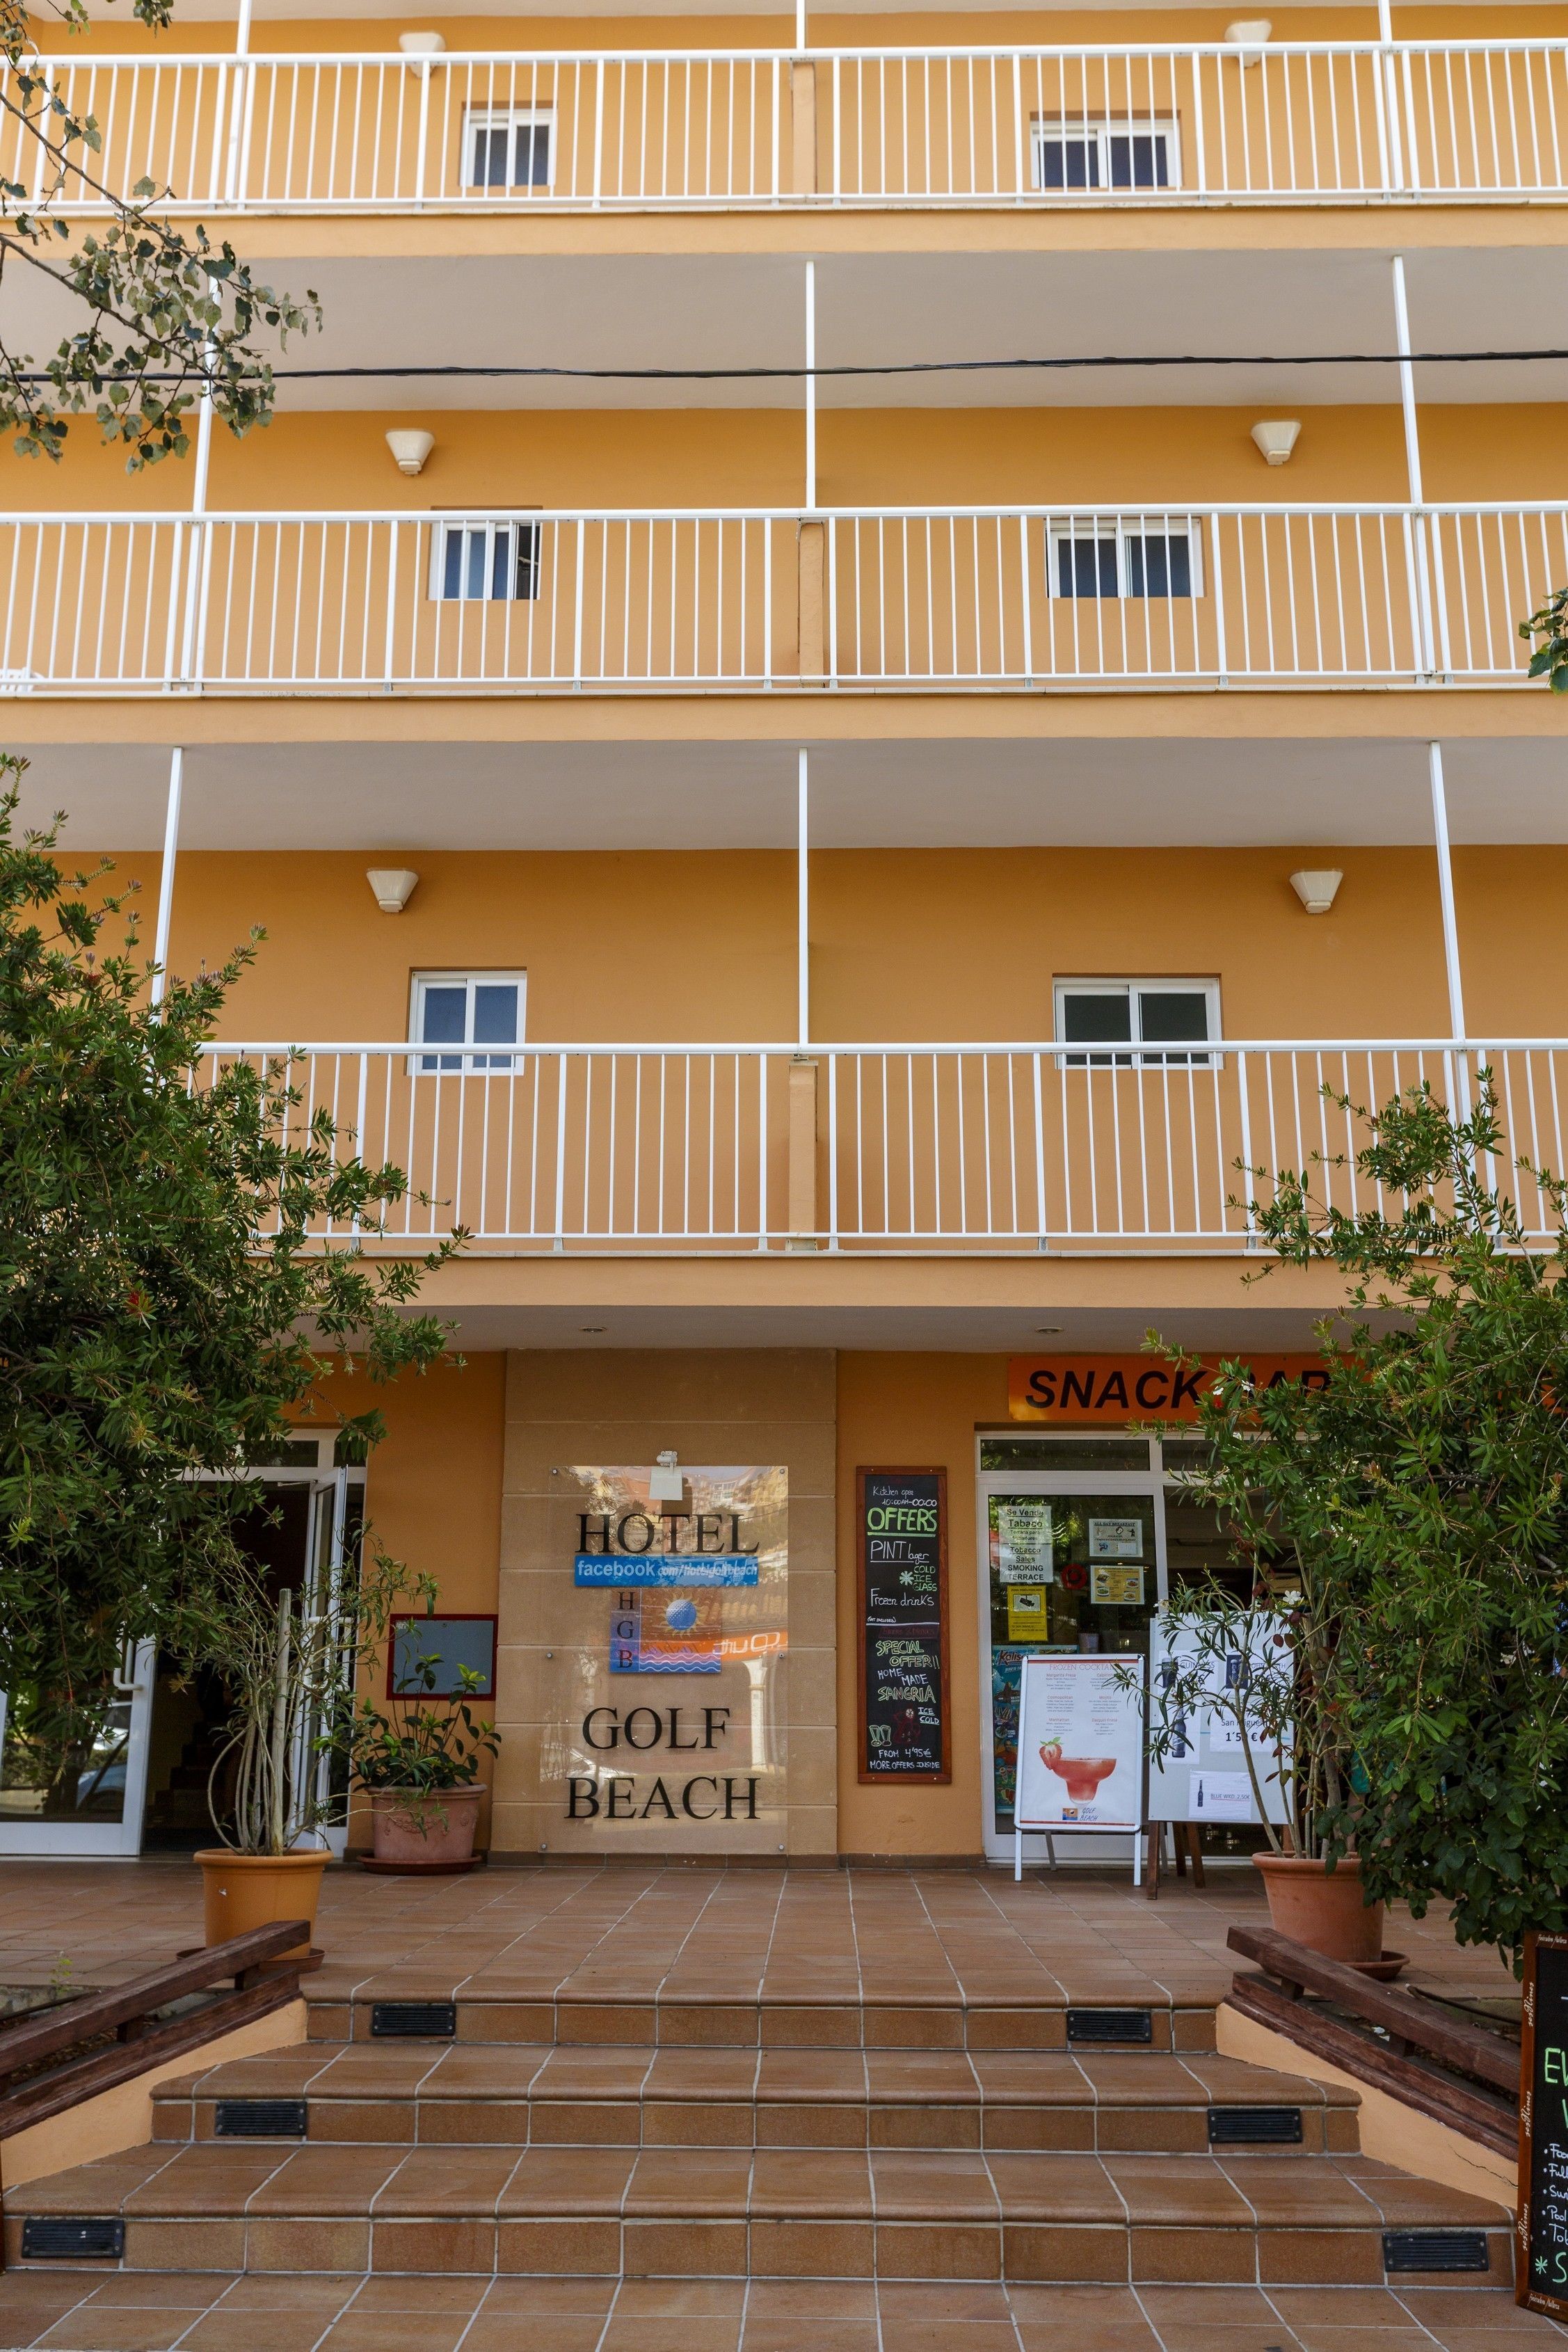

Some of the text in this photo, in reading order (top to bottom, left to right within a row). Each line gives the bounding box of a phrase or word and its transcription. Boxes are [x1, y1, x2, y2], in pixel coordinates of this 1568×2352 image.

[1025, 1370, 1208, 1409] SNACK
[873, 1486, 898, 1496] Kitchen
[867, 1507, 937, 1532] OFFERS
[1009, 1519, 1043, 1528] Tabaco
[575, 1514, 760, 1554] HOTEL
[871, 1540, 929, 1565] PINT lager
[913, 1565, 936, 1574] COLD
[913, 1574, 933, 1583] ICE
[913, 1583, 938, 1592] GLASS
[871, 1588, 934, 1607] Frozen drinks
[876, 1640, 925, 1656] SPECIAL
[878, 1668, 904, 1679] HOME
[902, 1674, 929, 1686] MADE
[878, 1685, 936, 1703] SANGRIA
[920, 1716, 939, 1725] COLD
[1237, 1718, 1262, 1728] iguel
[582, 1707, 730, 1750] GOLF
[879, 1750, 899, 1759] FROM
[870, 1760, 891, 1770] MORE
[891, 1761, 915, 1770] OFFERS
[564, 1777, 761, 1821] BEACH
[1549, 2143, 1568, 2159] Foo
[1546, 2205, 1567, 2222] Pool
